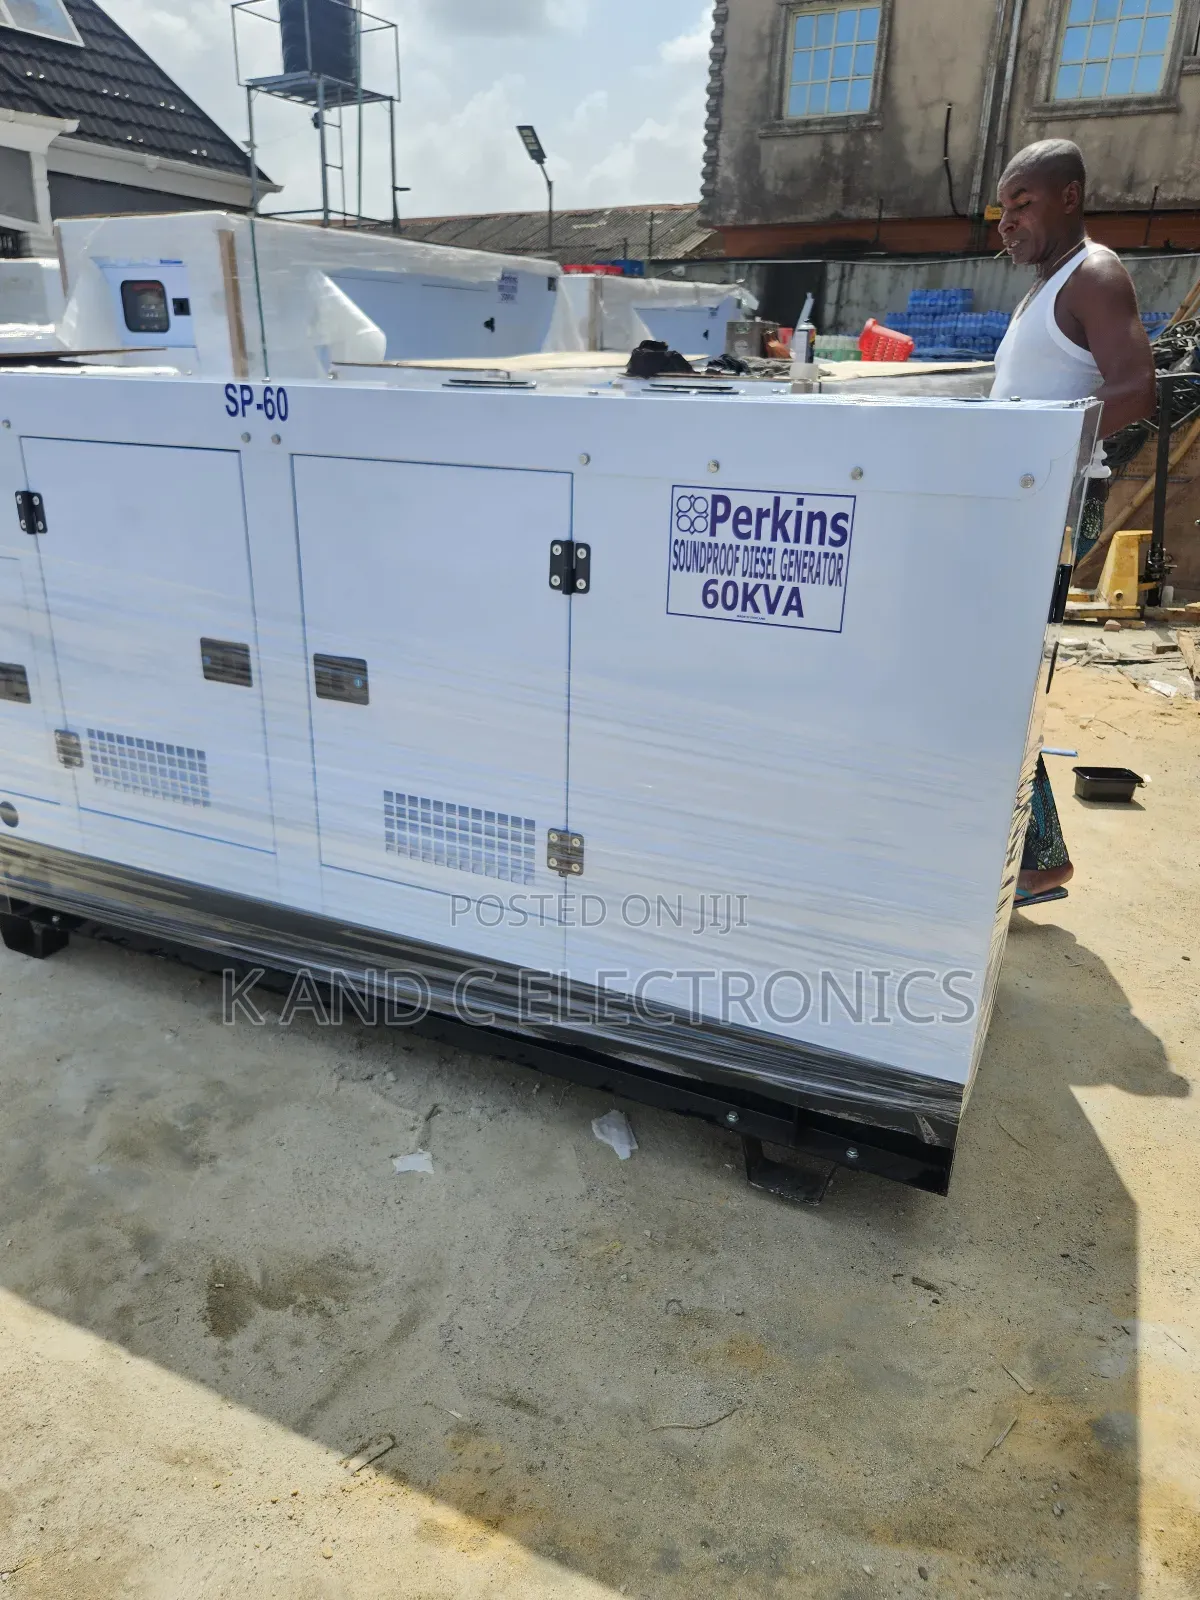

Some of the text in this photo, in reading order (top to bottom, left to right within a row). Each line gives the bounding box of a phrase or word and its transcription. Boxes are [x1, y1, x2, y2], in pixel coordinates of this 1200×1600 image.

[224, 383, 289, 421] SP-60
[709, 494, 849, 547] Perkins
[672, 539, 843, 587] SOUNDPROOF DIESEL GENERATOR
[702, 578, 804, 618] 60KVA
